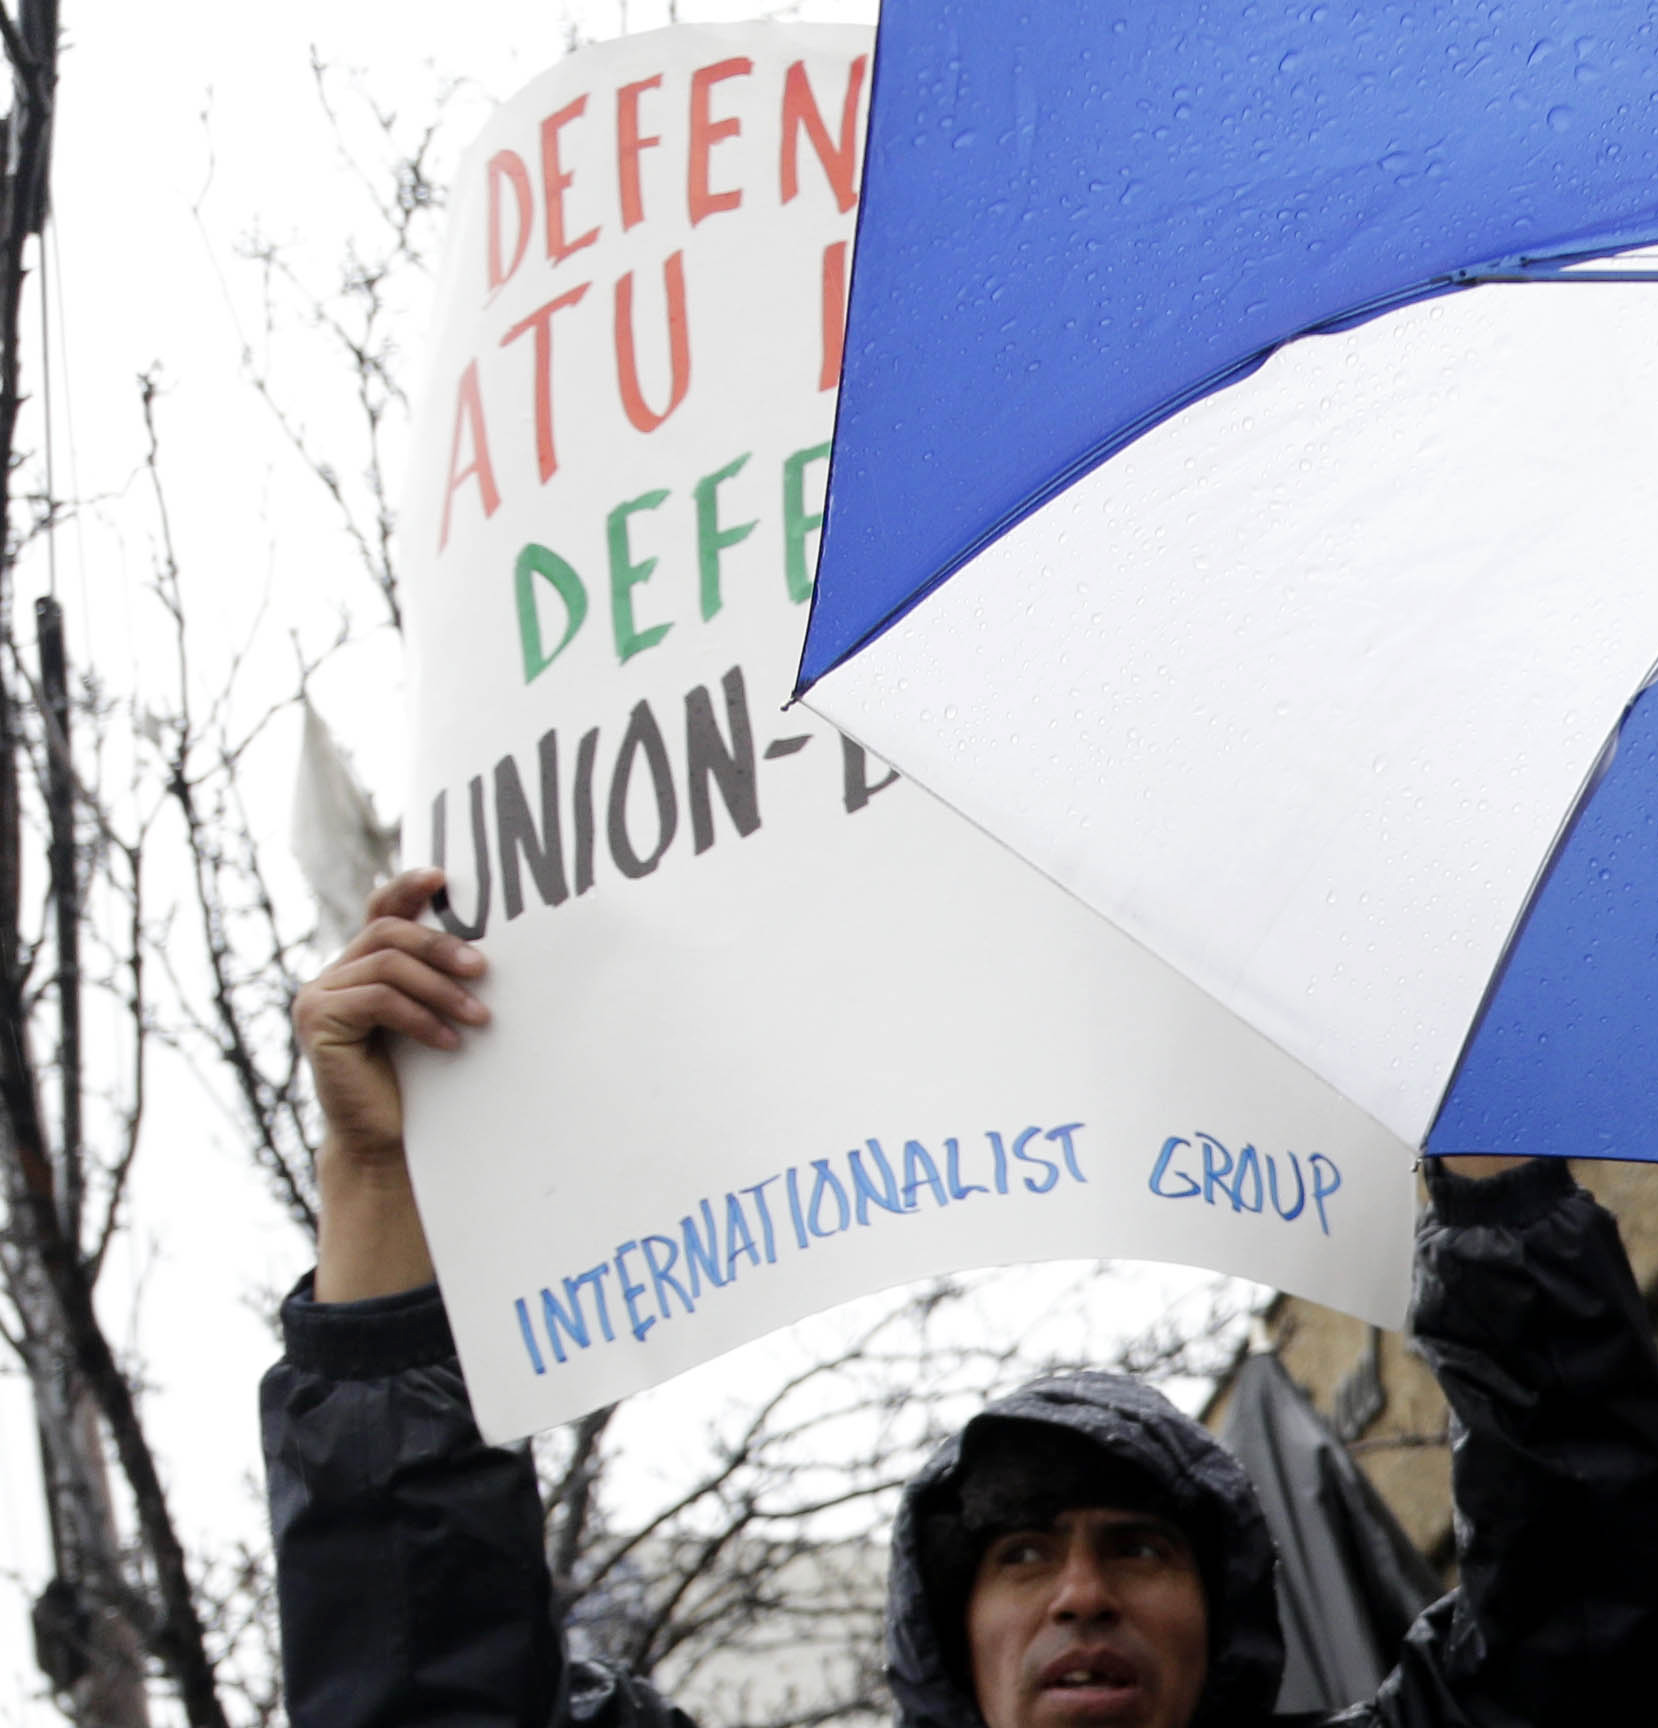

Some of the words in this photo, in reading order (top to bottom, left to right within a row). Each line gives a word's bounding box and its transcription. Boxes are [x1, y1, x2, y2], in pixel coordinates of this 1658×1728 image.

[438, 250, 692, 557] ATU
[514, 1122, 1087, 1378] INTERNATIONALIST
[1147, 1132, 1343, 1235] GROUP
